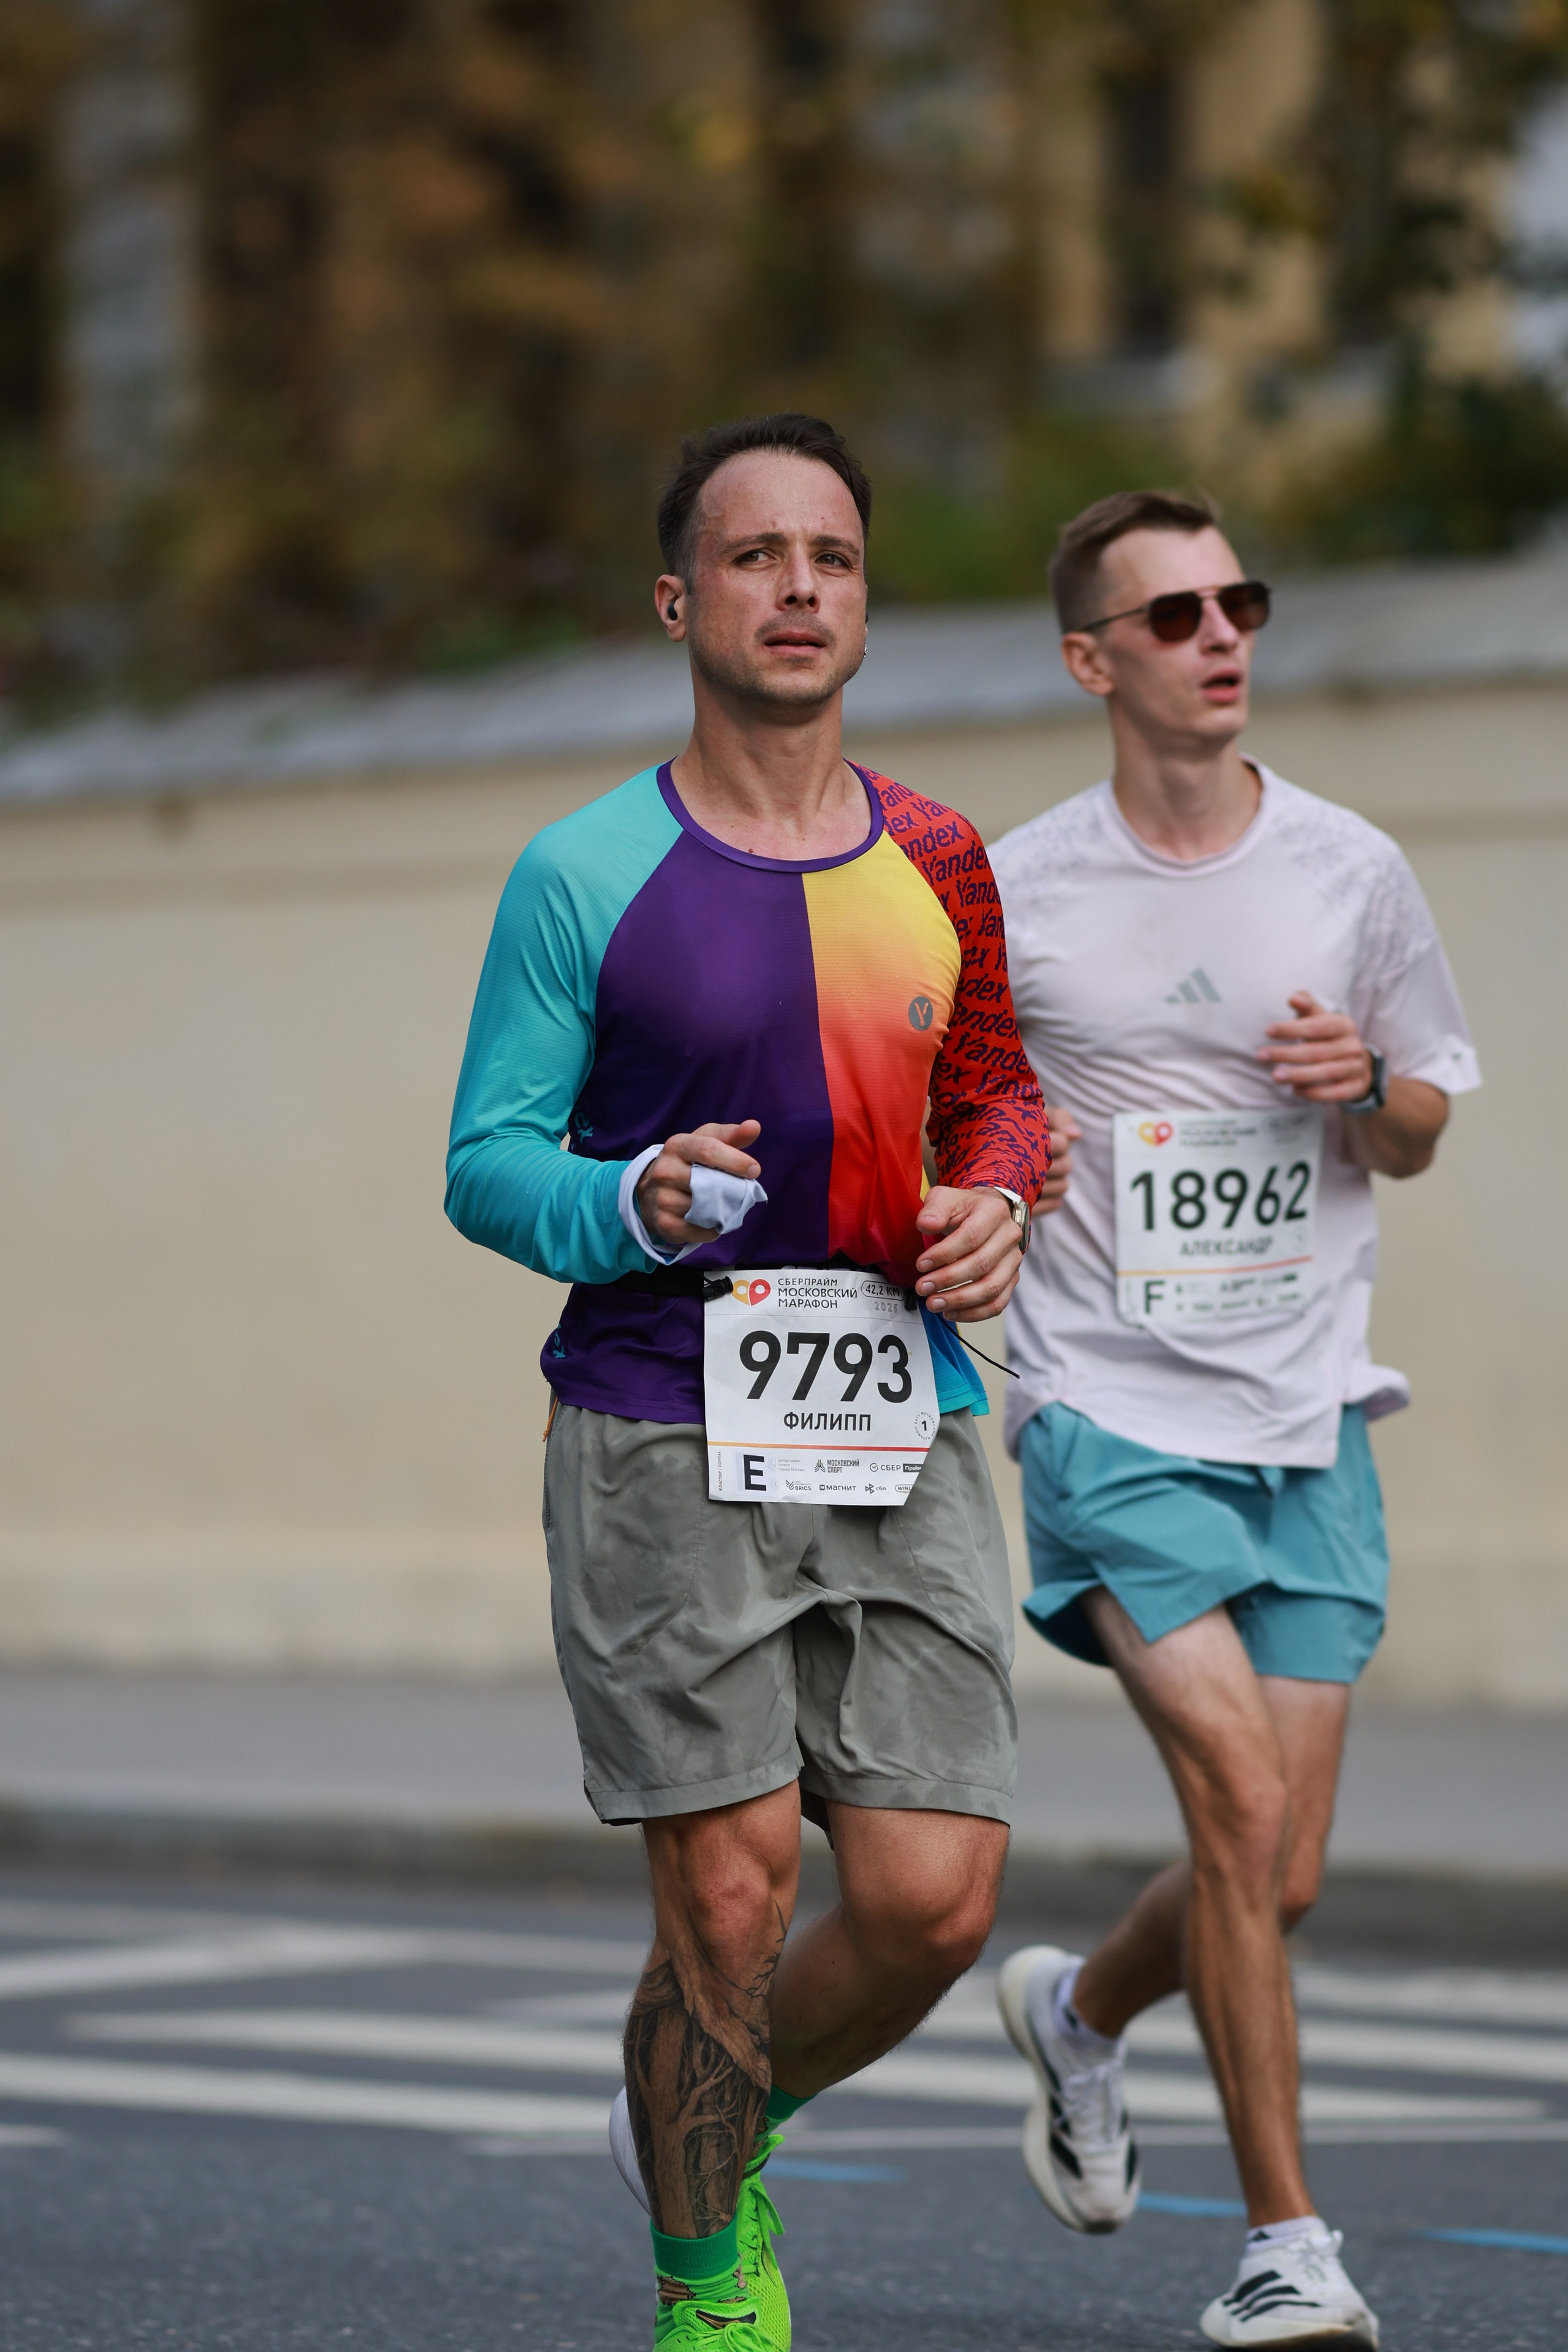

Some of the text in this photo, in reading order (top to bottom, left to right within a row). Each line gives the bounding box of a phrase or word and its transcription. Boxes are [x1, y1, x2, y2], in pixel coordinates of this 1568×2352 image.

[914, 1003, 929, 1027] Y
[1131, 1161, 1311, 1231] 18962
[1180, 1237, 1273, 1256] АЛЕКСАНДР
[778, 1277, 837, 1286] СБЕРПРАЙМ
[865, 1284, 900, 1297] 42,2 КМ
[778, 1287, 858, 1298] МОСКОВСКИЙ
[1144, 1280, 1165, 1314] F
[778, 1298, 838, 1308] МАРАФОН
[874, 1301, 898, 1313] 2026
[739, 1330, 913, 1403] 9793
[783, 1411, 872, 1431] ФИЛИПП
[922, 1420, 927, 1431] 1
[743, 1454, 766, 1491] E
